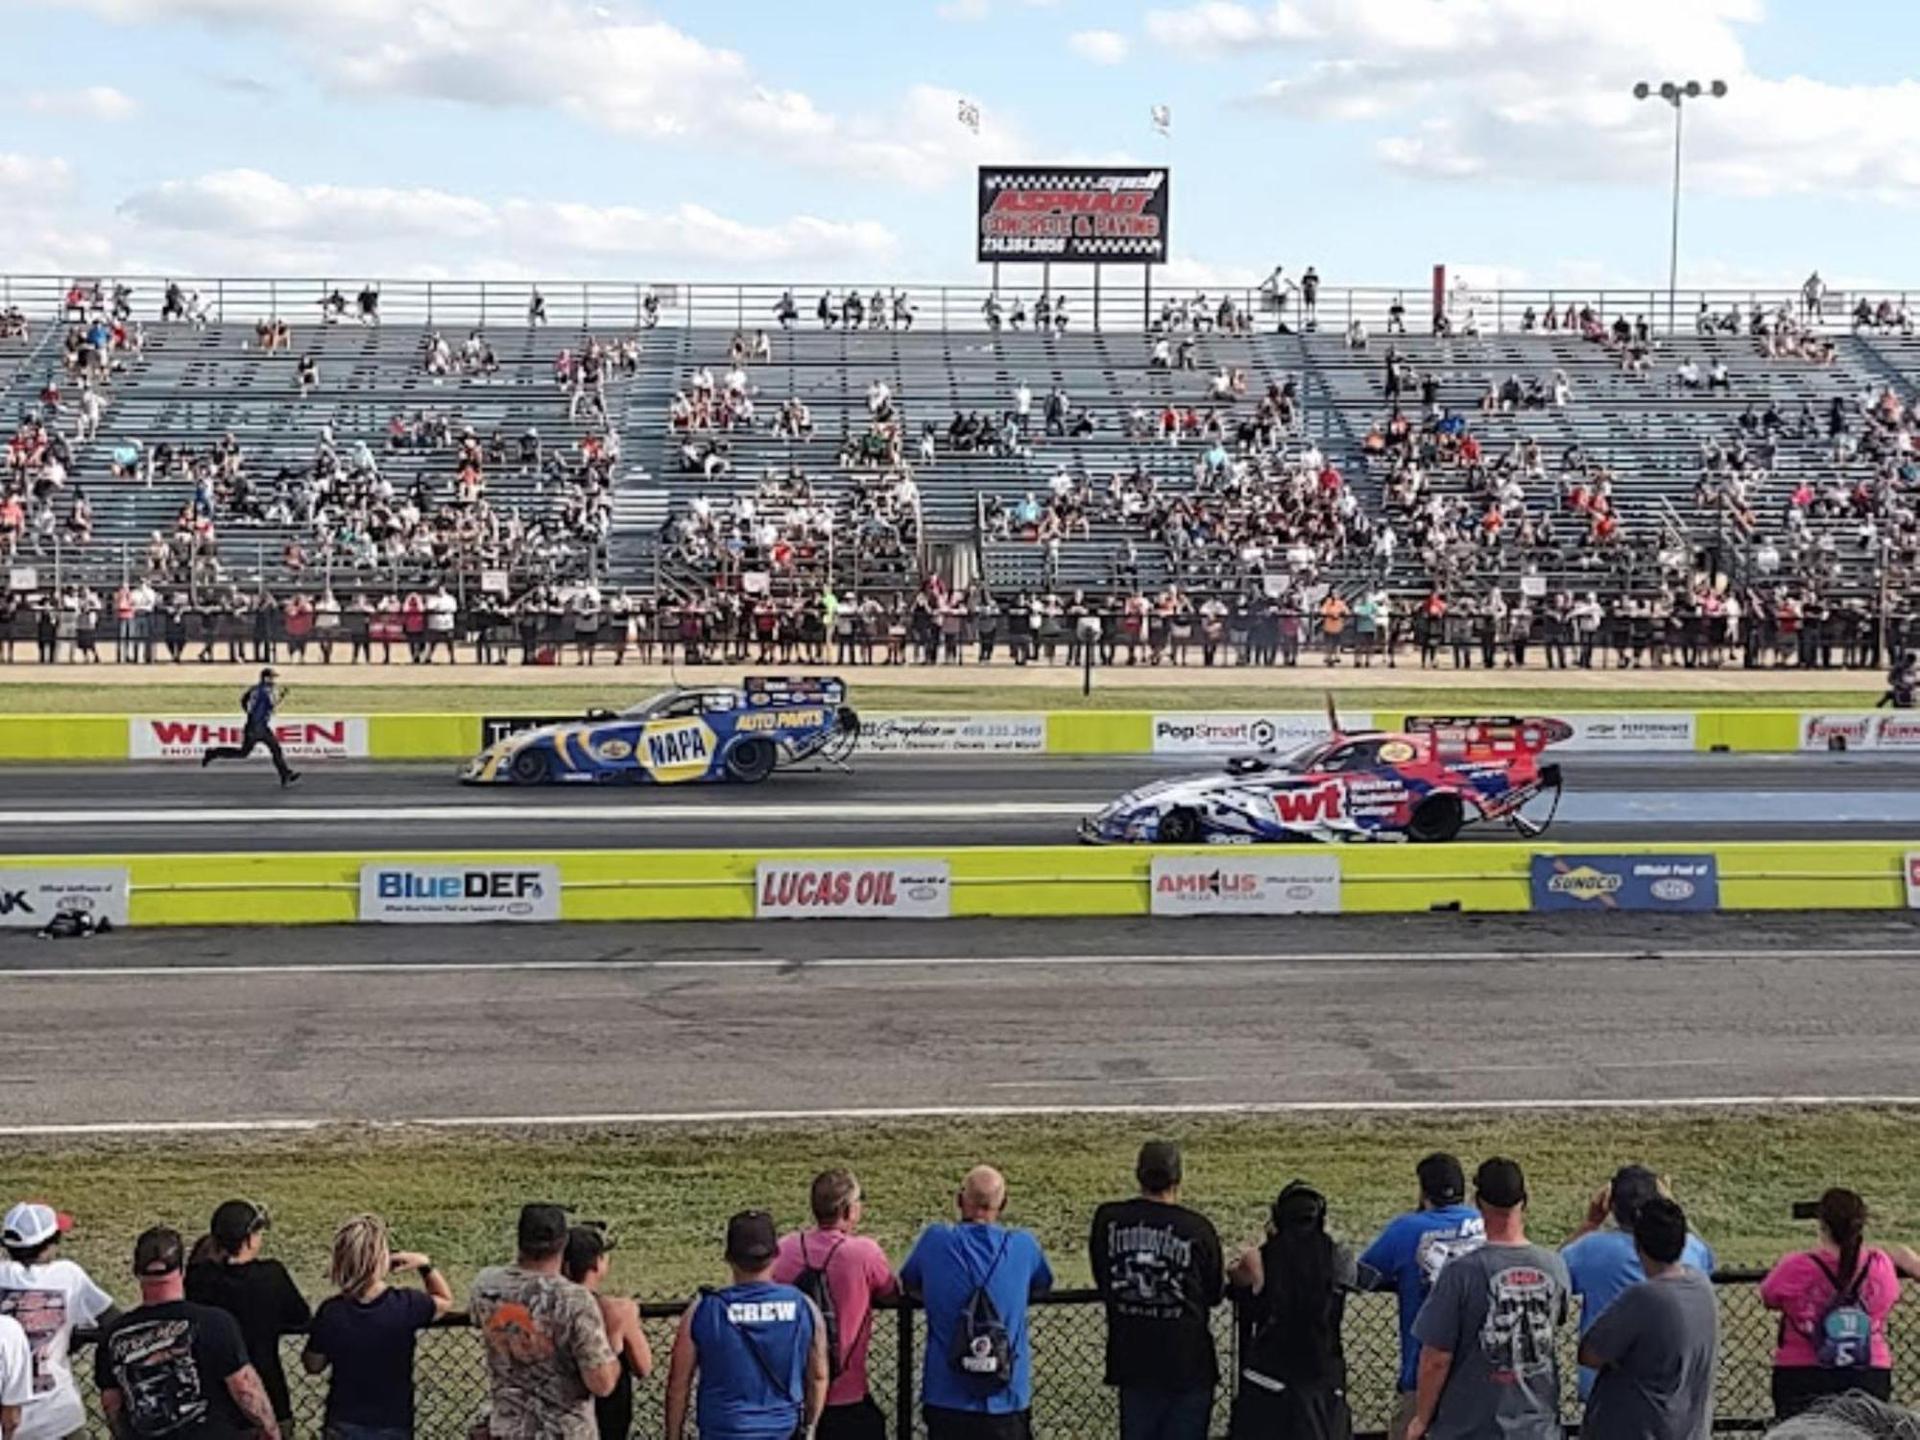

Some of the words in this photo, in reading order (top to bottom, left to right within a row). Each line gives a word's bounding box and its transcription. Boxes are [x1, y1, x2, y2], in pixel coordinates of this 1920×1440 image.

[647, 727, 706, 766] NAPA
[1273, 785, 1342, 822] wt
[378, 871, 541, 898] BlueDEF
[761, 871, 852, 906] LUCAS
[854, 871, 897, 906] OIL
[1551, 875, 1619, 890] SUNOCO
[728, 1301, 796, 1323] CREW
